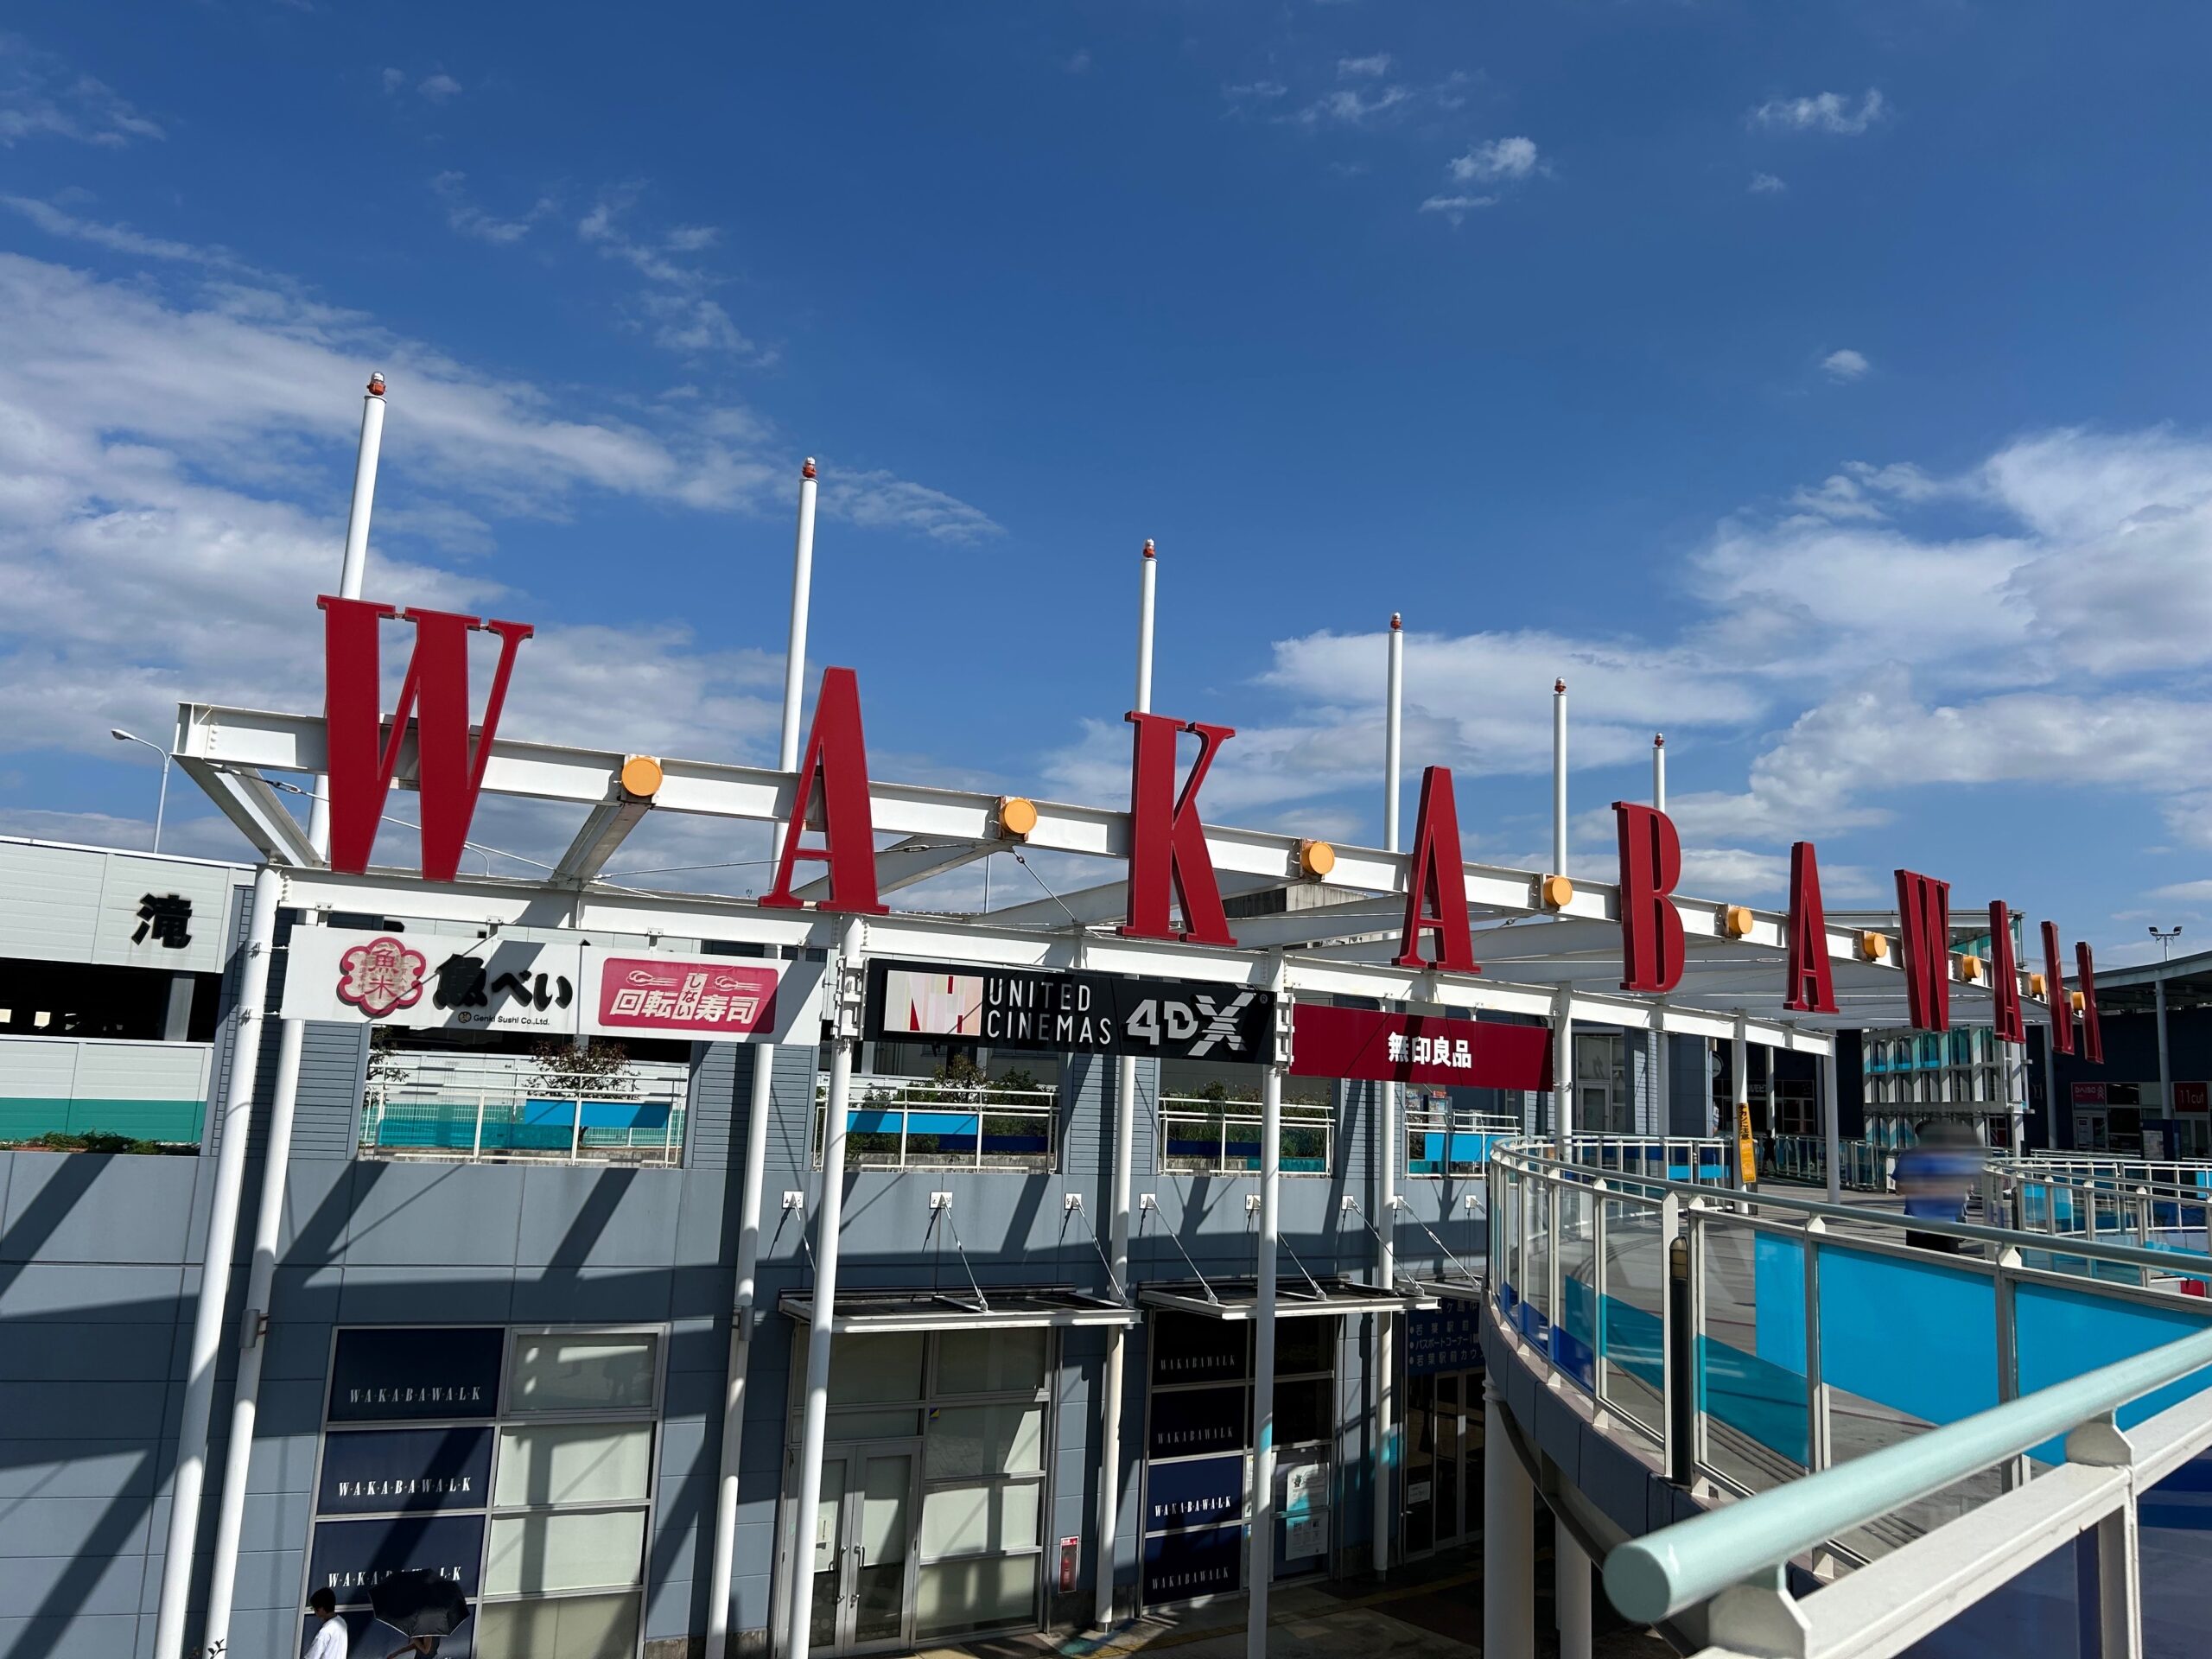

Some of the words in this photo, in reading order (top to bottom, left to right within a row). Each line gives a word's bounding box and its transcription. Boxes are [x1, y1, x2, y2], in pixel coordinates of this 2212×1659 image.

[609, 988, 678, 1019] 回転
[695, 995, 760, 1025] 寿司
[988, 977, 1091, 1012] UNITED
[474, 1014, 496, 1023] Genki
[498, 1015, 519, 1024] Sushi
[987, 1009, 1112, 1046] CINEMAS
[1126, 991, 1257, 1057] 4DX
[1388, 1031, 1471, 1069] 無印良品
